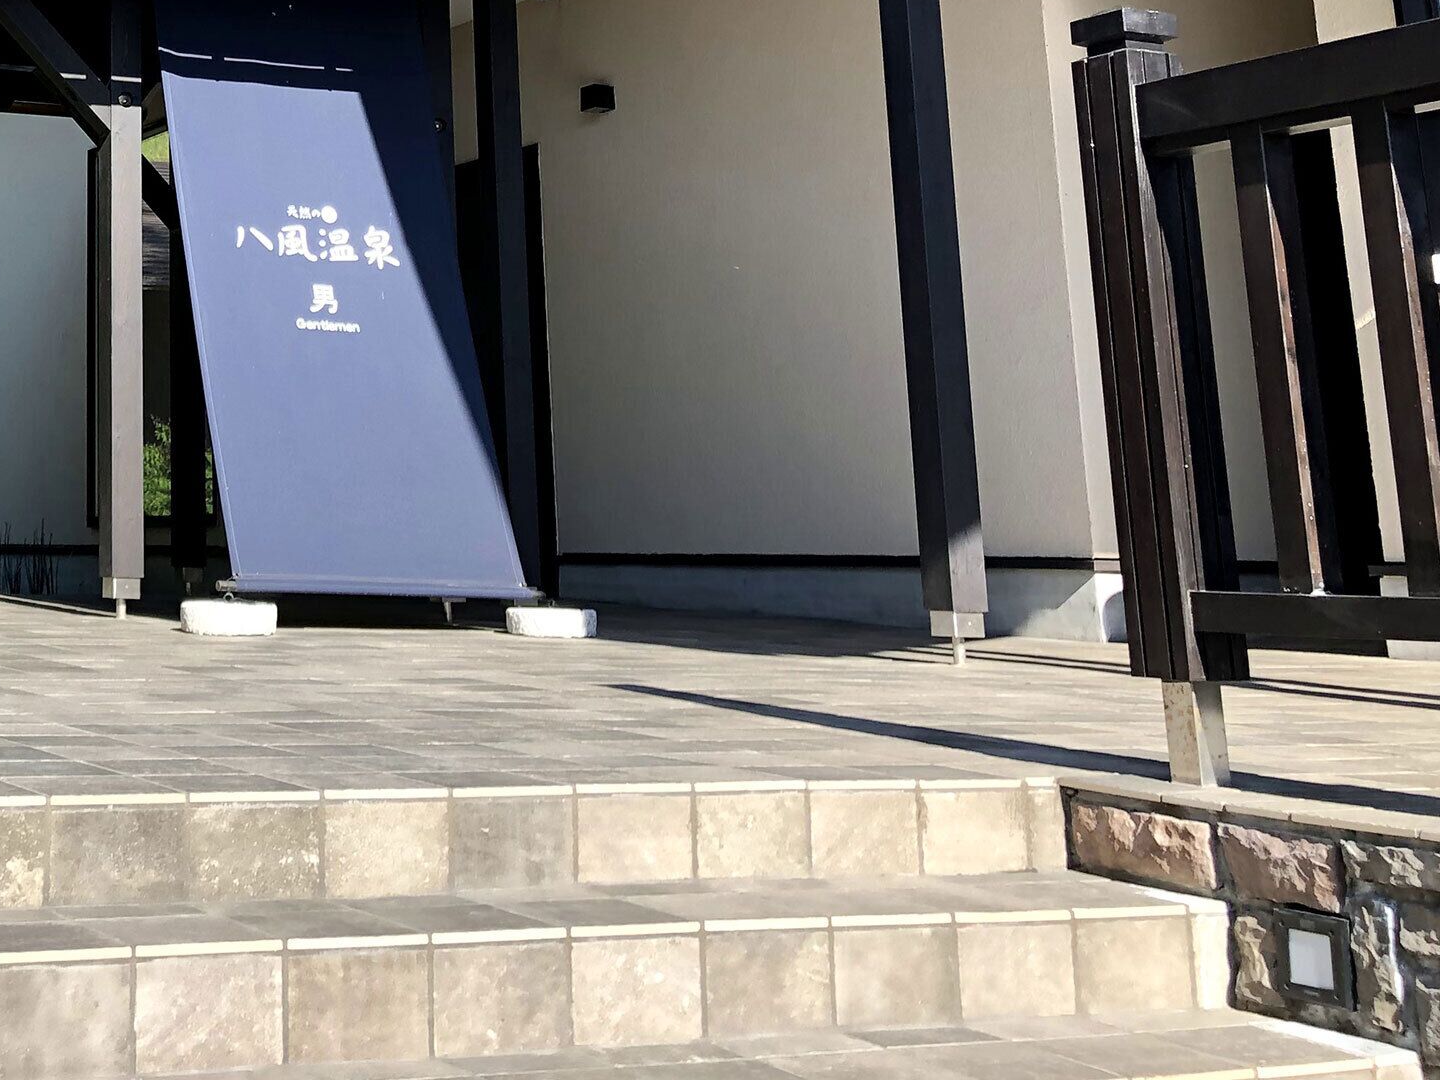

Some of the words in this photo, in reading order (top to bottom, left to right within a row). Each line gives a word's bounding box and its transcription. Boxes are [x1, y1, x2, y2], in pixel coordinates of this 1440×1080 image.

[236, 223, 401, 270] 八風温泉
[309, 283, 339, 314] 男
